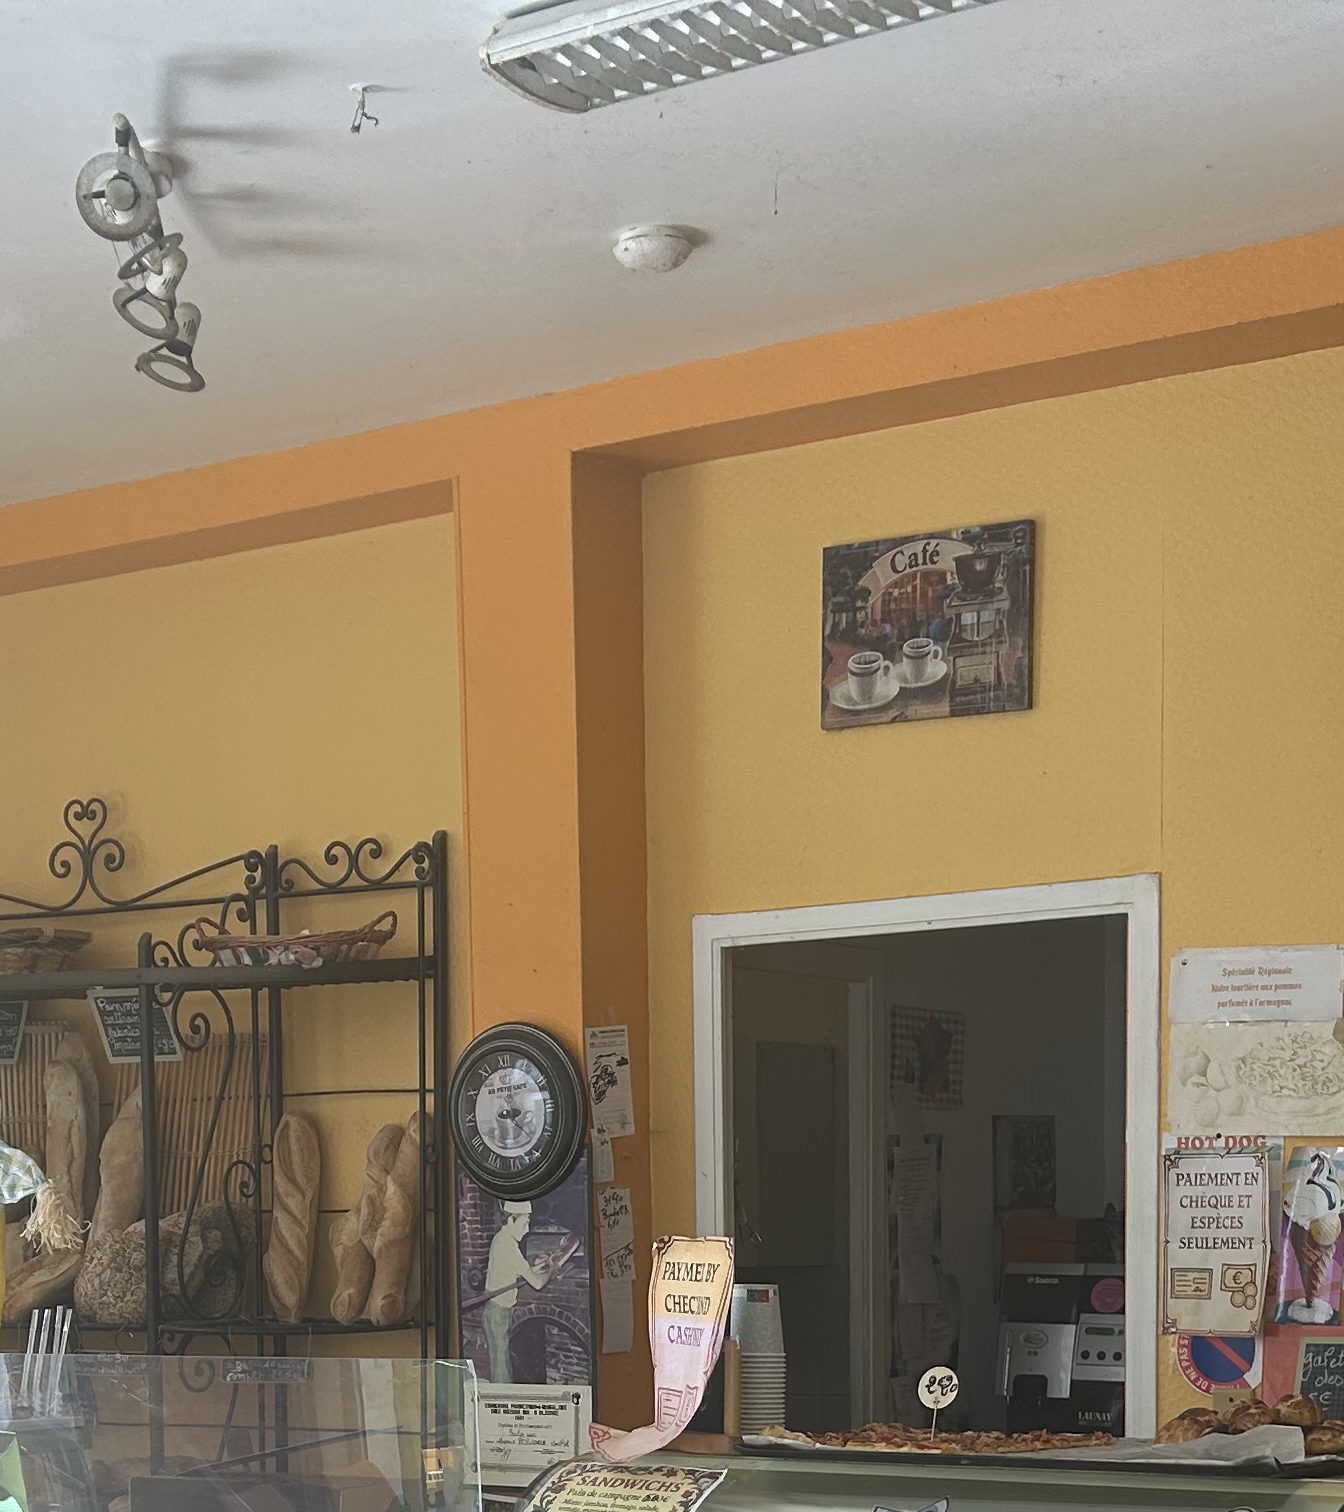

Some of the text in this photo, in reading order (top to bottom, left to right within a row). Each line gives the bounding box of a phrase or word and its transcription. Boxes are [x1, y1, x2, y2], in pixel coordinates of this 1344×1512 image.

[890, 541, 940, 574] Café
[1258, 966, 1292, 977] Régionale
[1274, 983, 1302, 992] pommes
[1176, 1135, 1267, 1151] HOT DOG
[1175, 1172, 1259, 1187] PAIEMENT EN
[1179, 1191, 1252, 1210] CHÈQUE ET
[1190, 1213, 1244, 1230] ESPÈCES
[1178, 1236, 1255, 1250] SEULEMENT
[1185, 1366, 1198, 1381] NE
[1315, 1369, 1343, 1387] des
[1195, 1378, 1209, 1390] DE
[1078, 1411, 1113, 1422] LAUNAY
[576, 1476, 685, 1493] SANDWICHS
[567, 1488, 643, 1501] Pain de campagne
